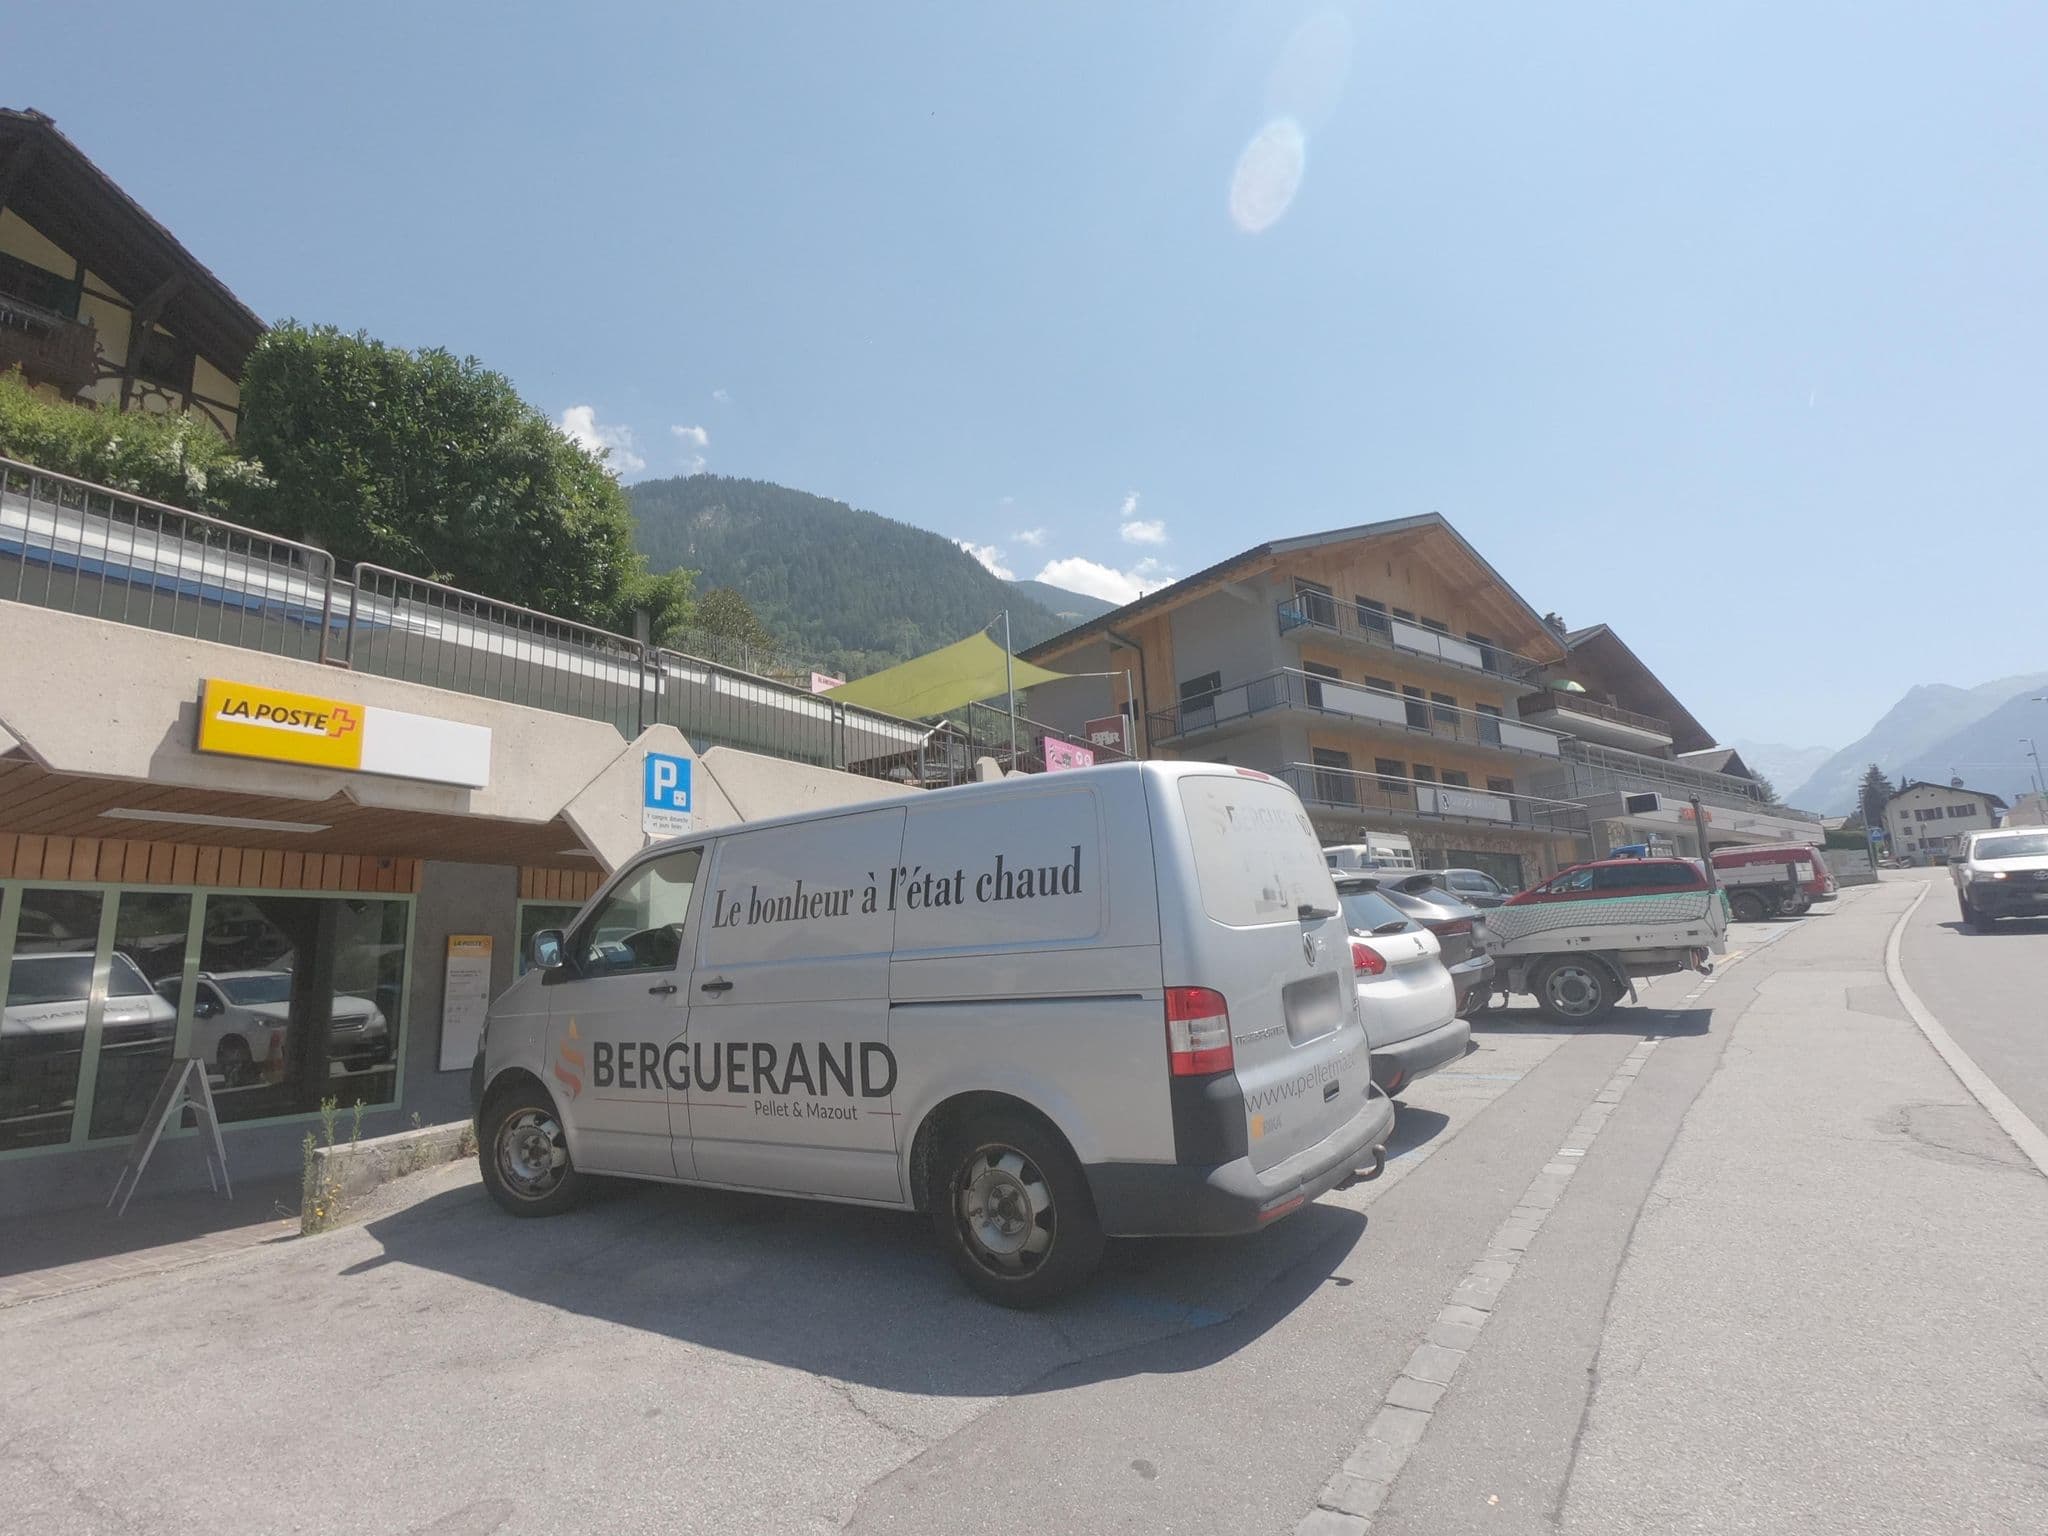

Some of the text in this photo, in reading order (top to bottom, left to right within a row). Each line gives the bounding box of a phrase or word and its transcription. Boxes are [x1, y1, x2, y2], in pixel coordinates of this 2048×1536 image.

[221, 698, 329, 730] LA POSTE
[654, 759, 677, 801] P
[712, 845, 1082, 928] Le bonheur à l'état chaud
[593, 1041, 897, 1098] BERGUERAND
[754, 1100, 858, 1121] Pellet & Mazout
